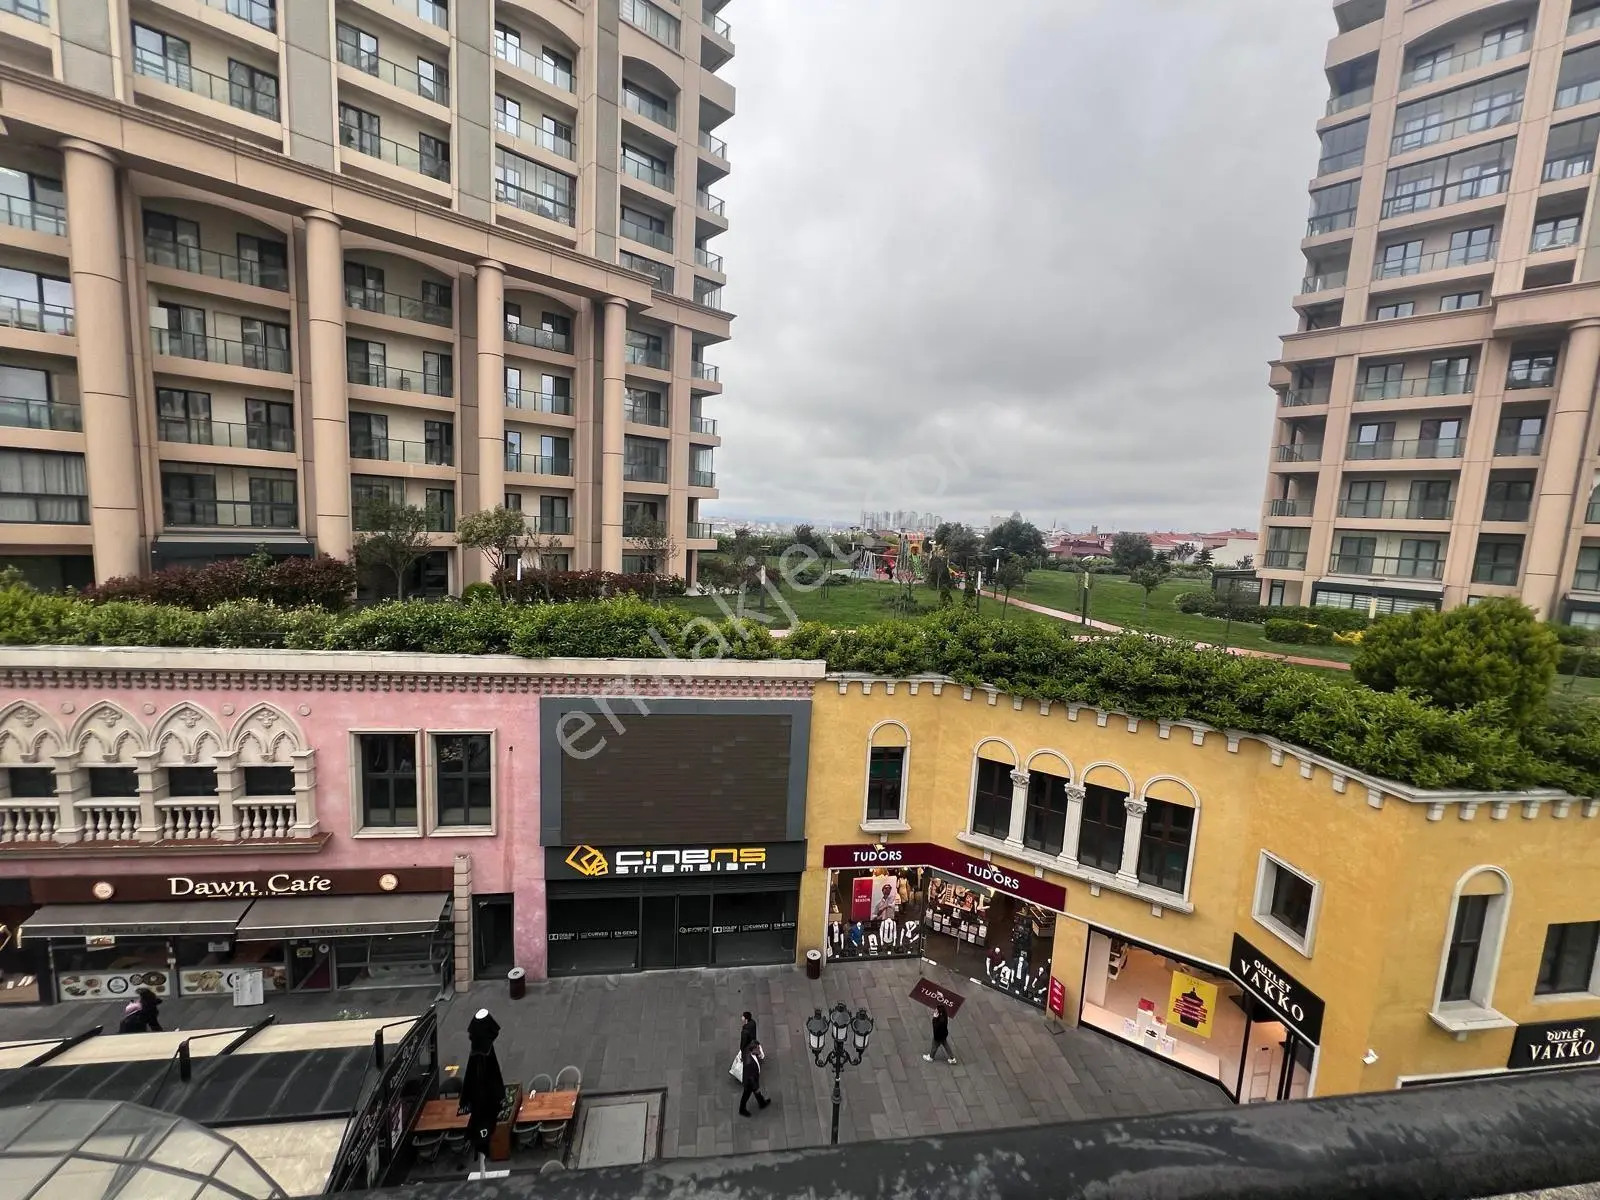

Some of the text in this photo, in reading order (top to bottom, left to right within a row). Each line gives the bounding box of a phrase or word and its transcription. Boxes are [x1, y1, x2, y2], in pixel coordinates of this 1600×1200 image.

[853, 851, 902, 862] TUDORS
[167, 874, 331, 895] Dawn Cafe
[967, 863, 1019, 889] TUDORS
[1254, 960, 1292, 993] OUTLET
[921, 987, 954, 1008] TUDORS
[1241, 959, 1304, 1021] VAKKO
[1546, 1028, 1586, 1041] OUTLET
[1530, 1040, 1595, 1061] VAKKO
